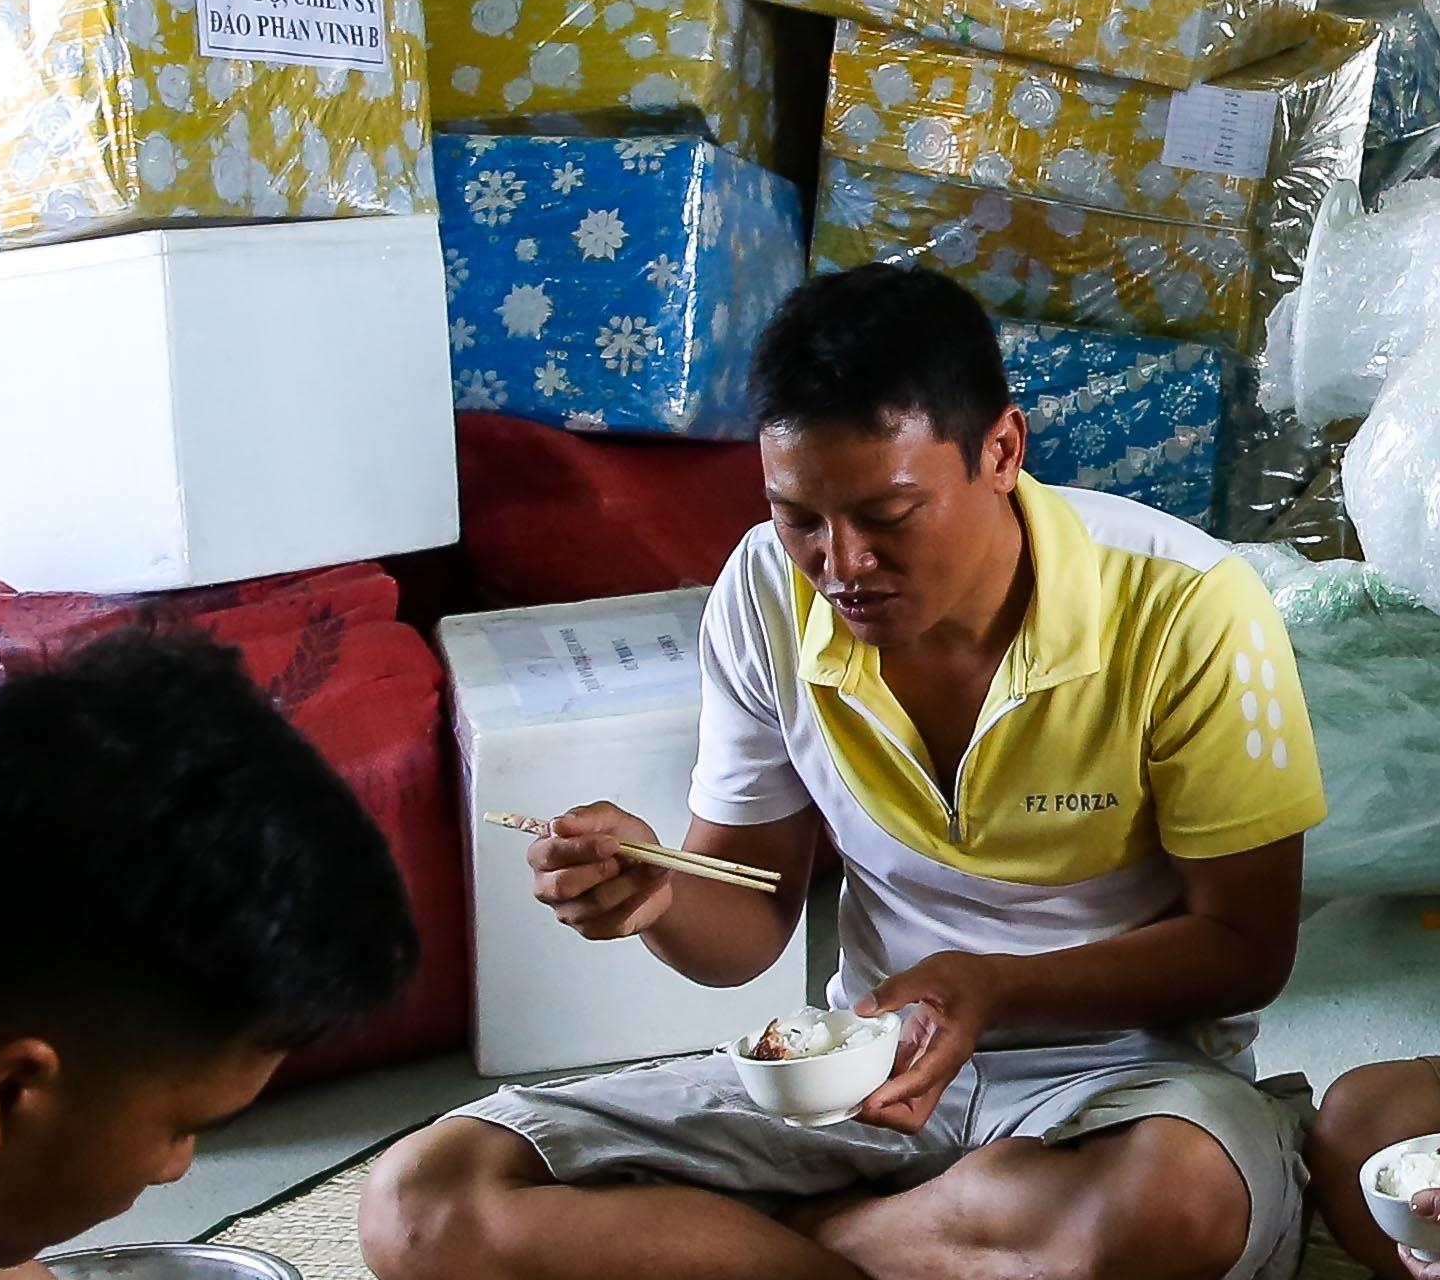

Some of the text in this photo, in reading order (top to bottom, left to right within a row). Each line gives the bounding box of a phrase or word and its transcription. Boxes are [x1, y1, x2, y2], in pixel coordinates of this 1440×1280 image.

[210, 5, 380, 48] ĐẢO PHAN VINH B
[1025, 792, 1120, 813] FZ FORZA
